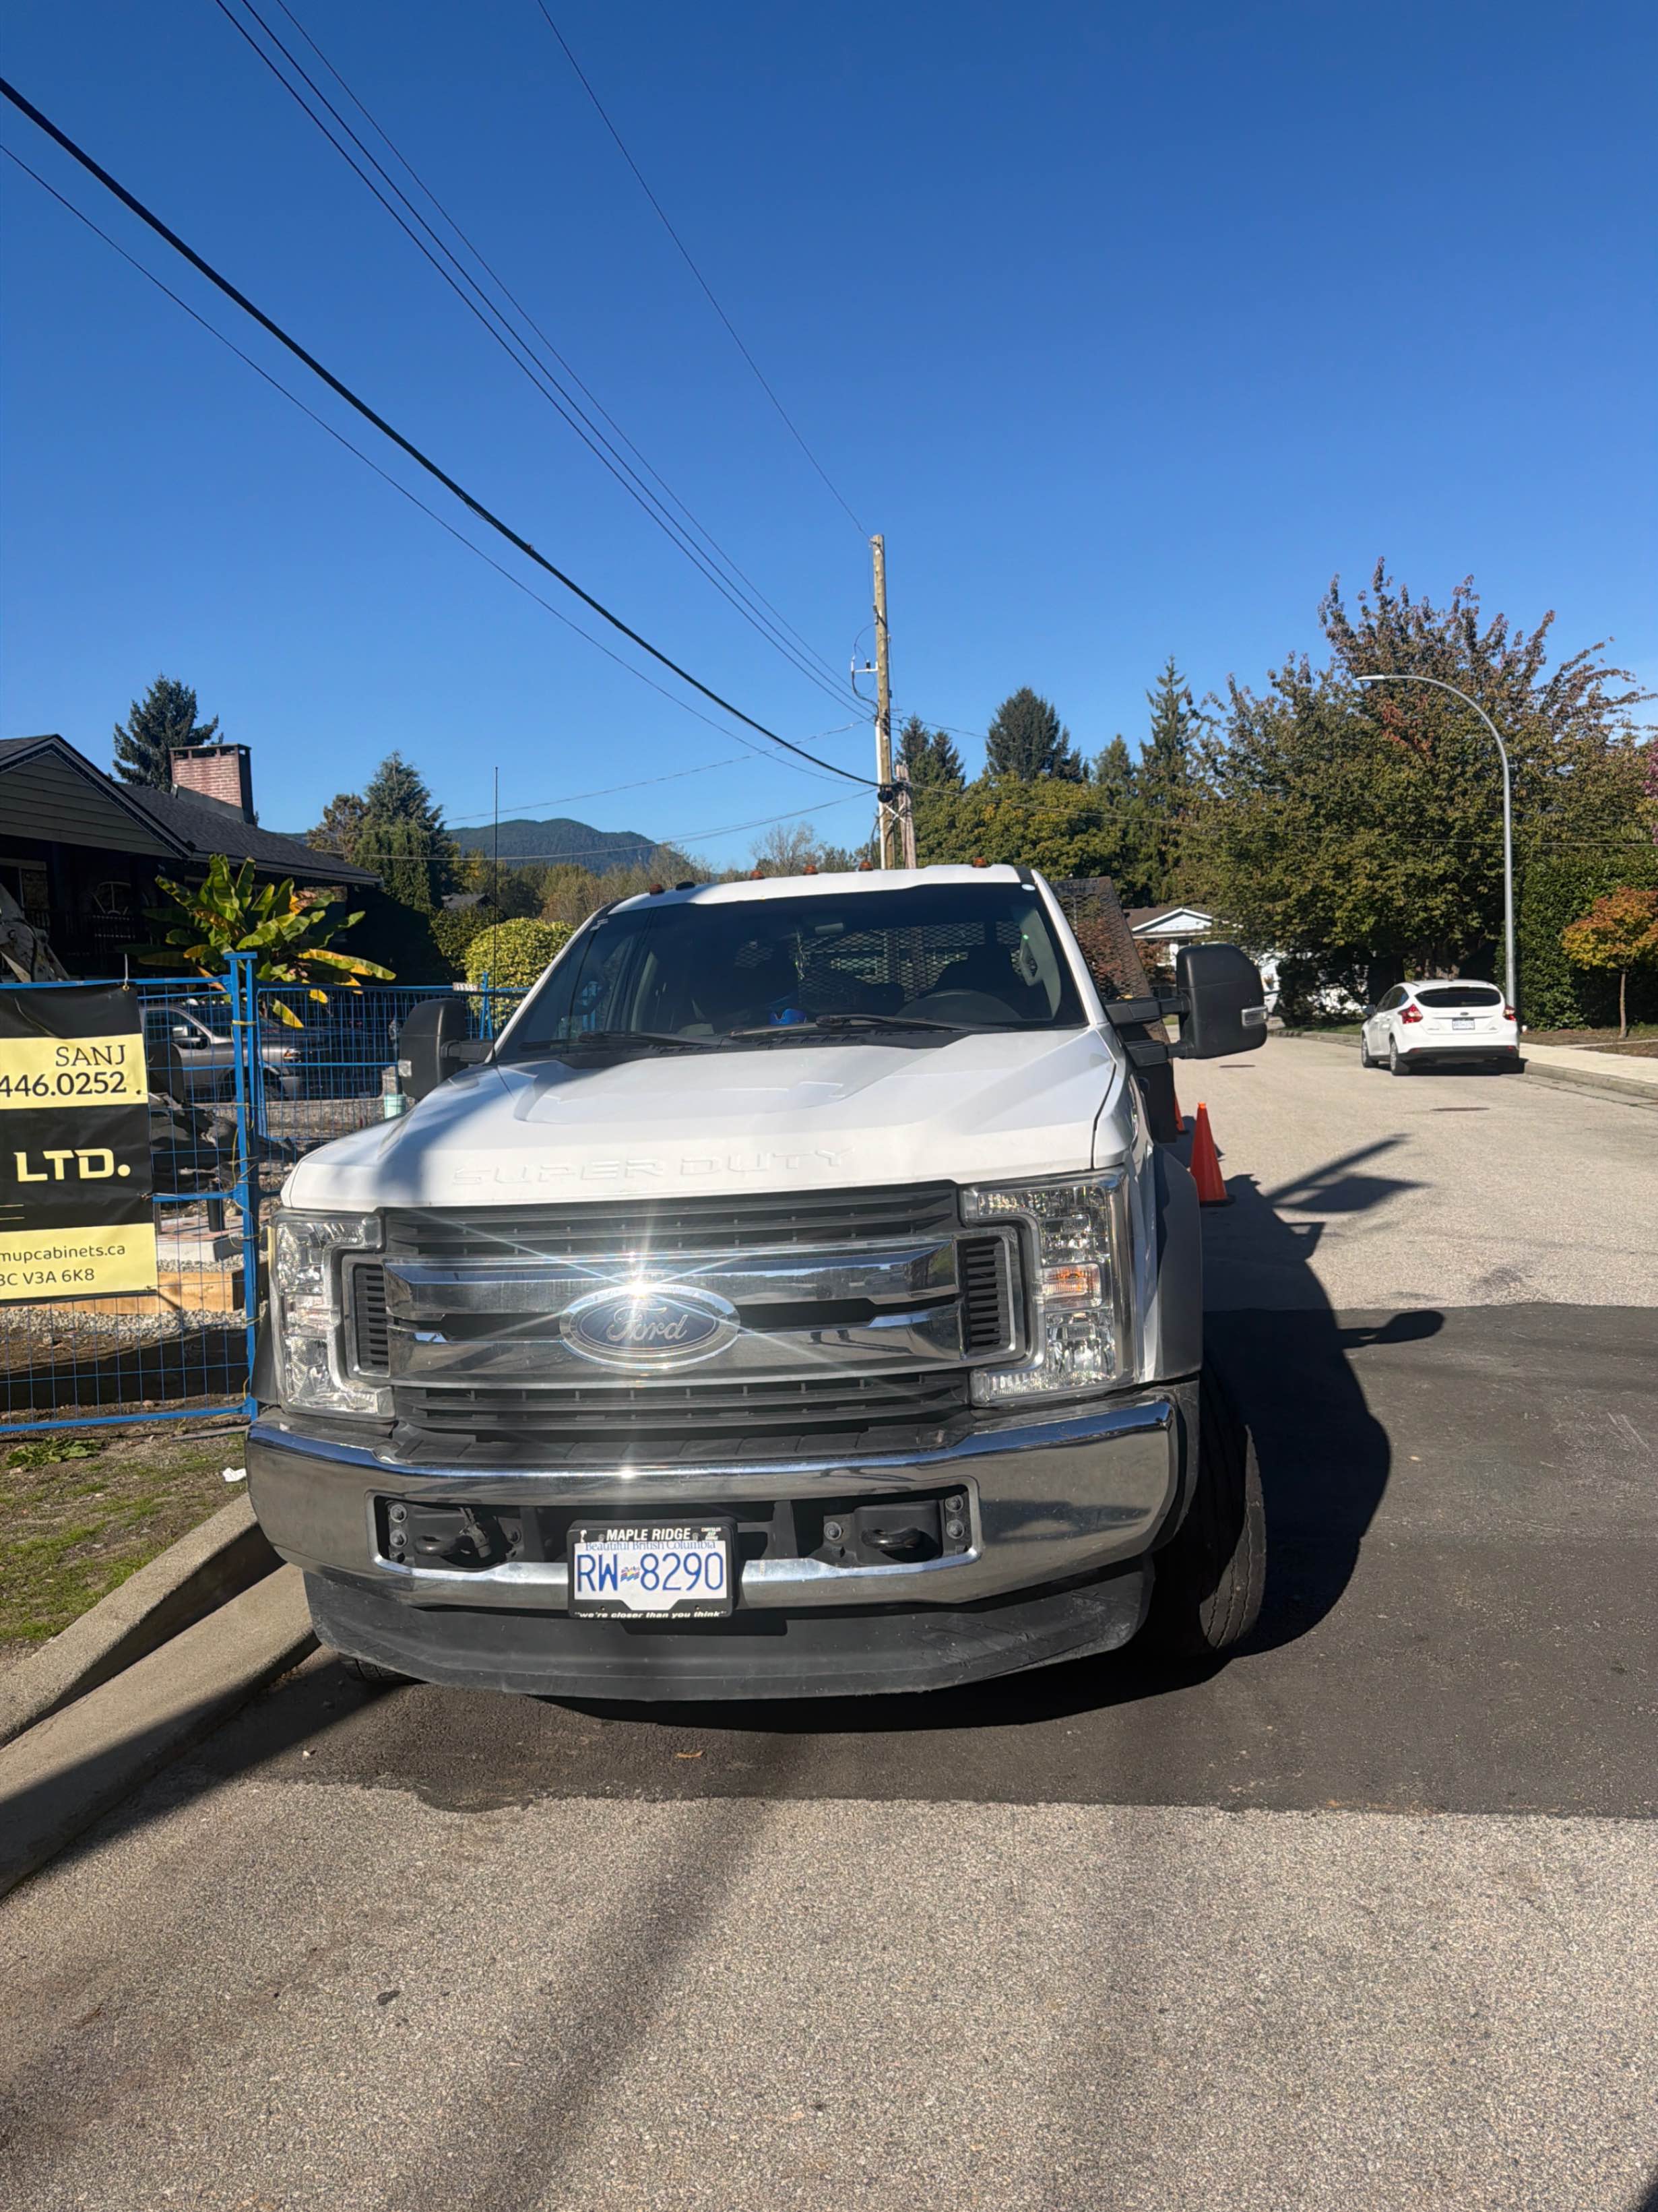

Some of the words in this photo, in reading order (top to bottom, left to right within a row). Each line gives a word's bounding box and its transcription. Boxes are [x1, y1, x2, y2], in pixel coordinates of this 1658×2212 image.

[56, 1044, 126, 1067] SANJ
[0, 1071, 127, 1098] 446.0252
[13, 1148, 131, 1182] LTD.
[453, 1158, 664, 1184] SUPER
[680, 1147, 856, 1176] DUTY
[23, 1271, 57, 1285] V3A
[61, 1268, 95, 1283] 6K8
[607, 1306, 689, 1341] Ford
[585, 1542, 629, 1552] Beautiful
[633, 1541, 664, 1550] British
[666, 1540, 716, 1550] Columbia
[606, 1529, 648, 1542] MAPLE
[651, 1527, 691, 1541] RIDGE
[577, 1554, 618, 1592] RW
[640, 1552, 724, 1591] 8290
[672, 1612, 691, 1620] you
